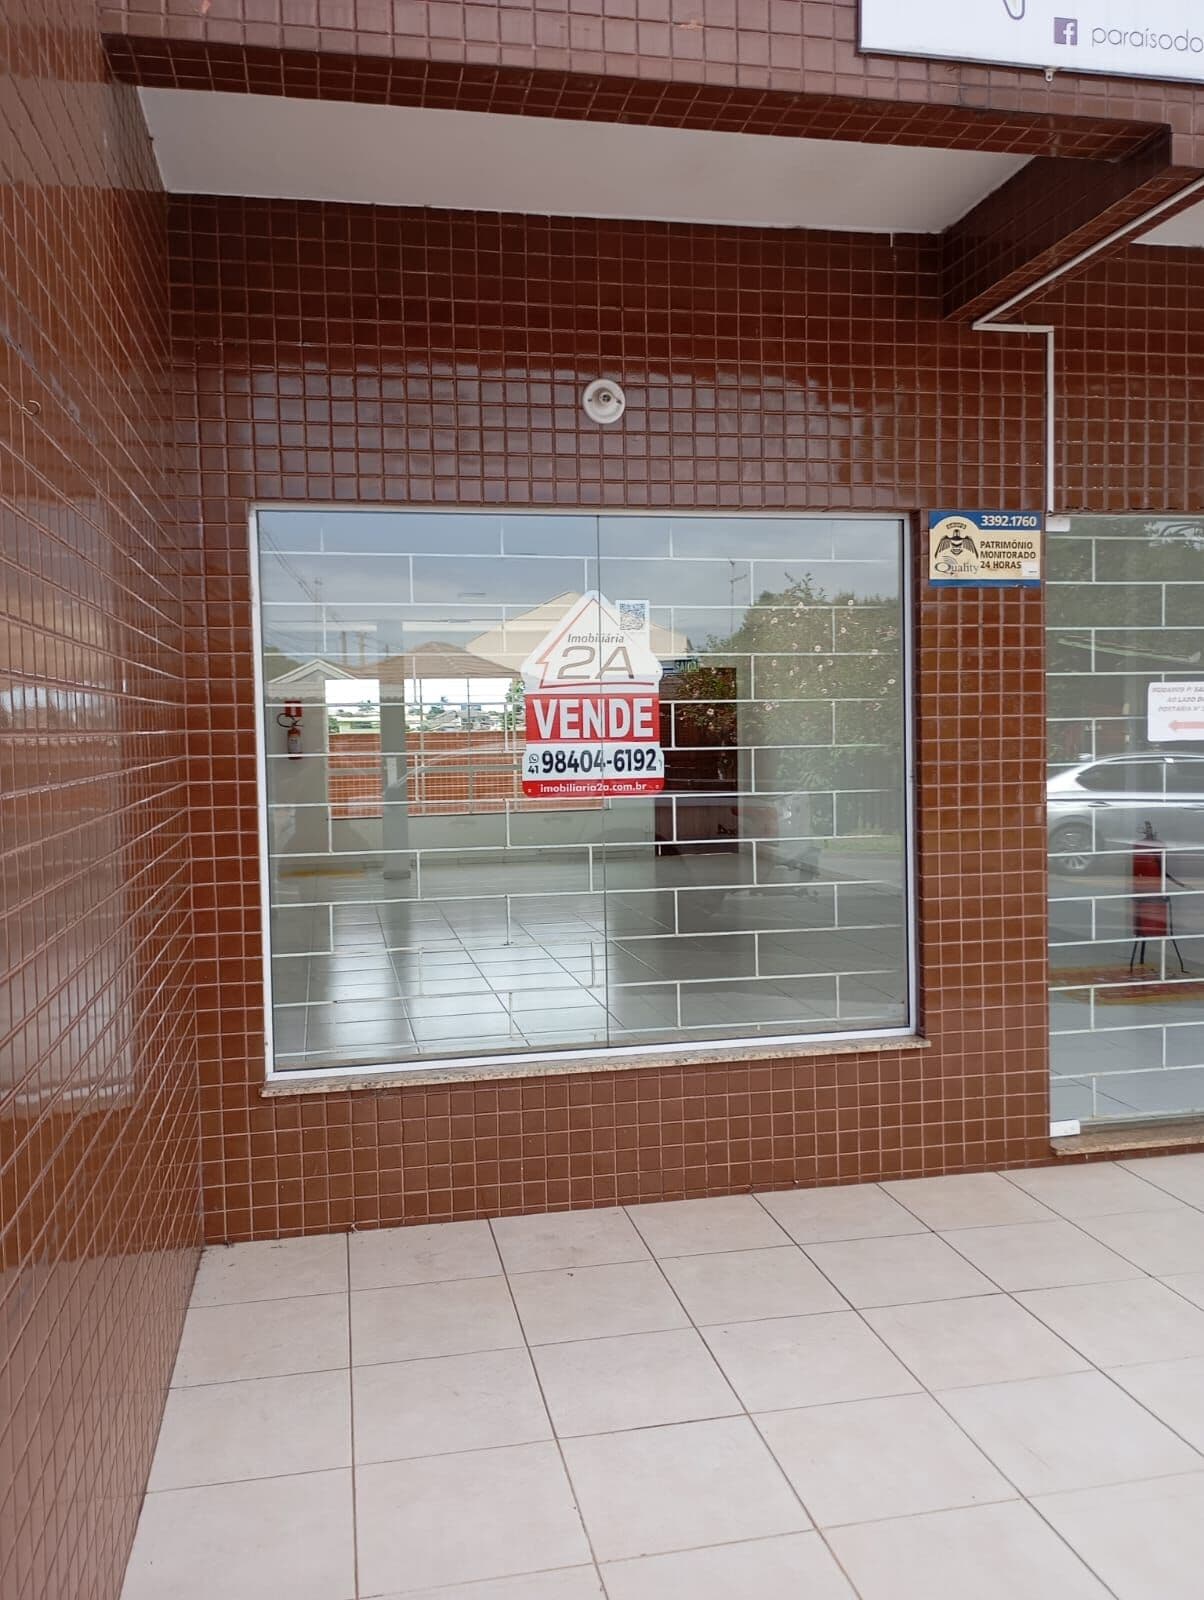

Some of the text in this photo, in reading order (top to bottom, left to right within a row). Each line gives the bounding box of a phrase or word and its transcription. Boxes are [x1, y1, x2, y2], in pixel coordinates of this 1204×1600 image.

[980, 515, 1037, 527] 3392.1760
[980, 551, 1036, 559] MONITORADO
[934, 561, 978, 576] Quality
[980, 561, 1022, 569] 24 HORAS
[567, 633, 625, 644] Imobiliária
[557, 645, 635, 680] 2A
[533, 697, 655, 740] VENDE
[528, 748, 657, 775] 41 98404-6192
[540, 781, 647, 794] imobiliaria2a.com.br
